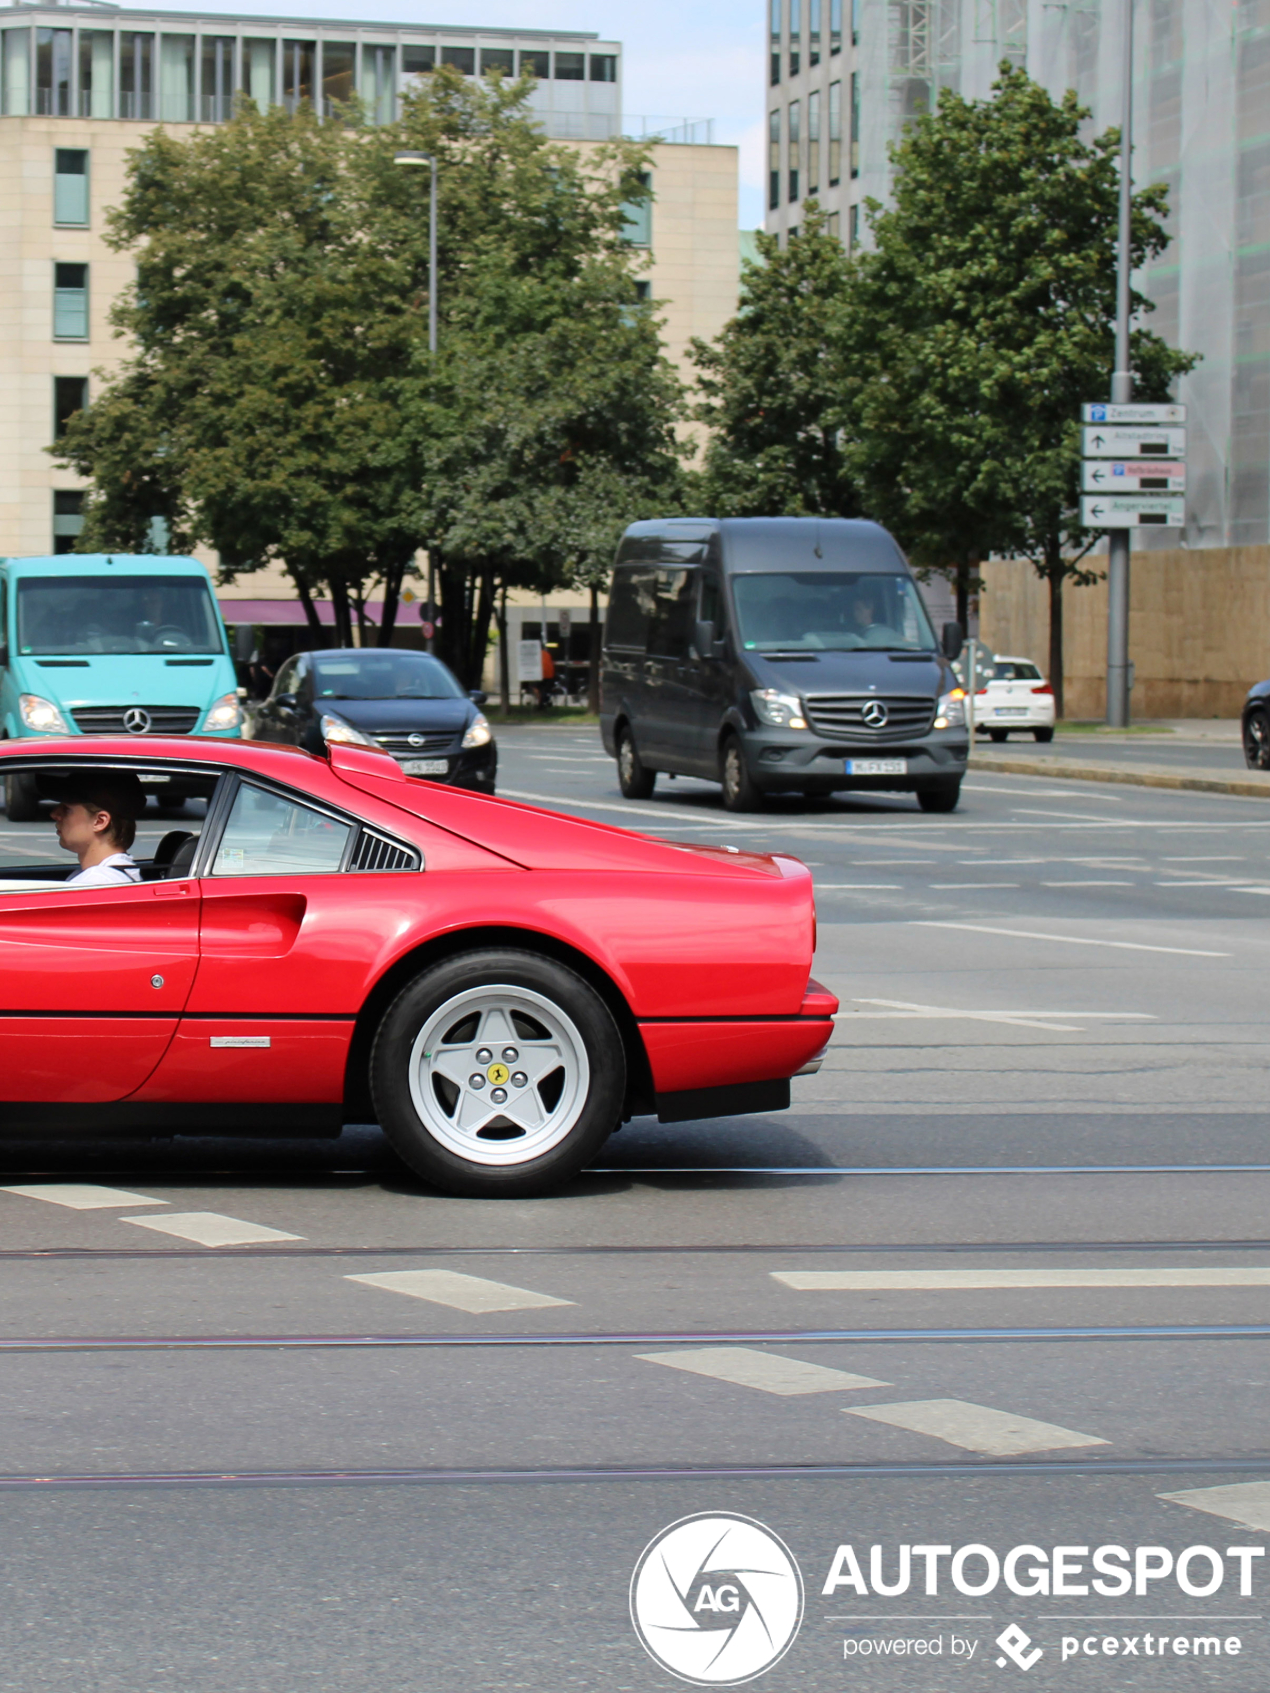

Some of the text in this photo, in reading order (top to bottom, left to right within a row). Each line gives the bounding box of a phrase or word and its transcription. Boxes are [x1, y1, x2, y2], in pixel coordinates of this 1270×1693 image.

[1111, 408, 1155, 418] Zentrum
[1114, 431, 1169, 443] Altstadtring
[1112, 502, 1172, 512] Angerviertel
